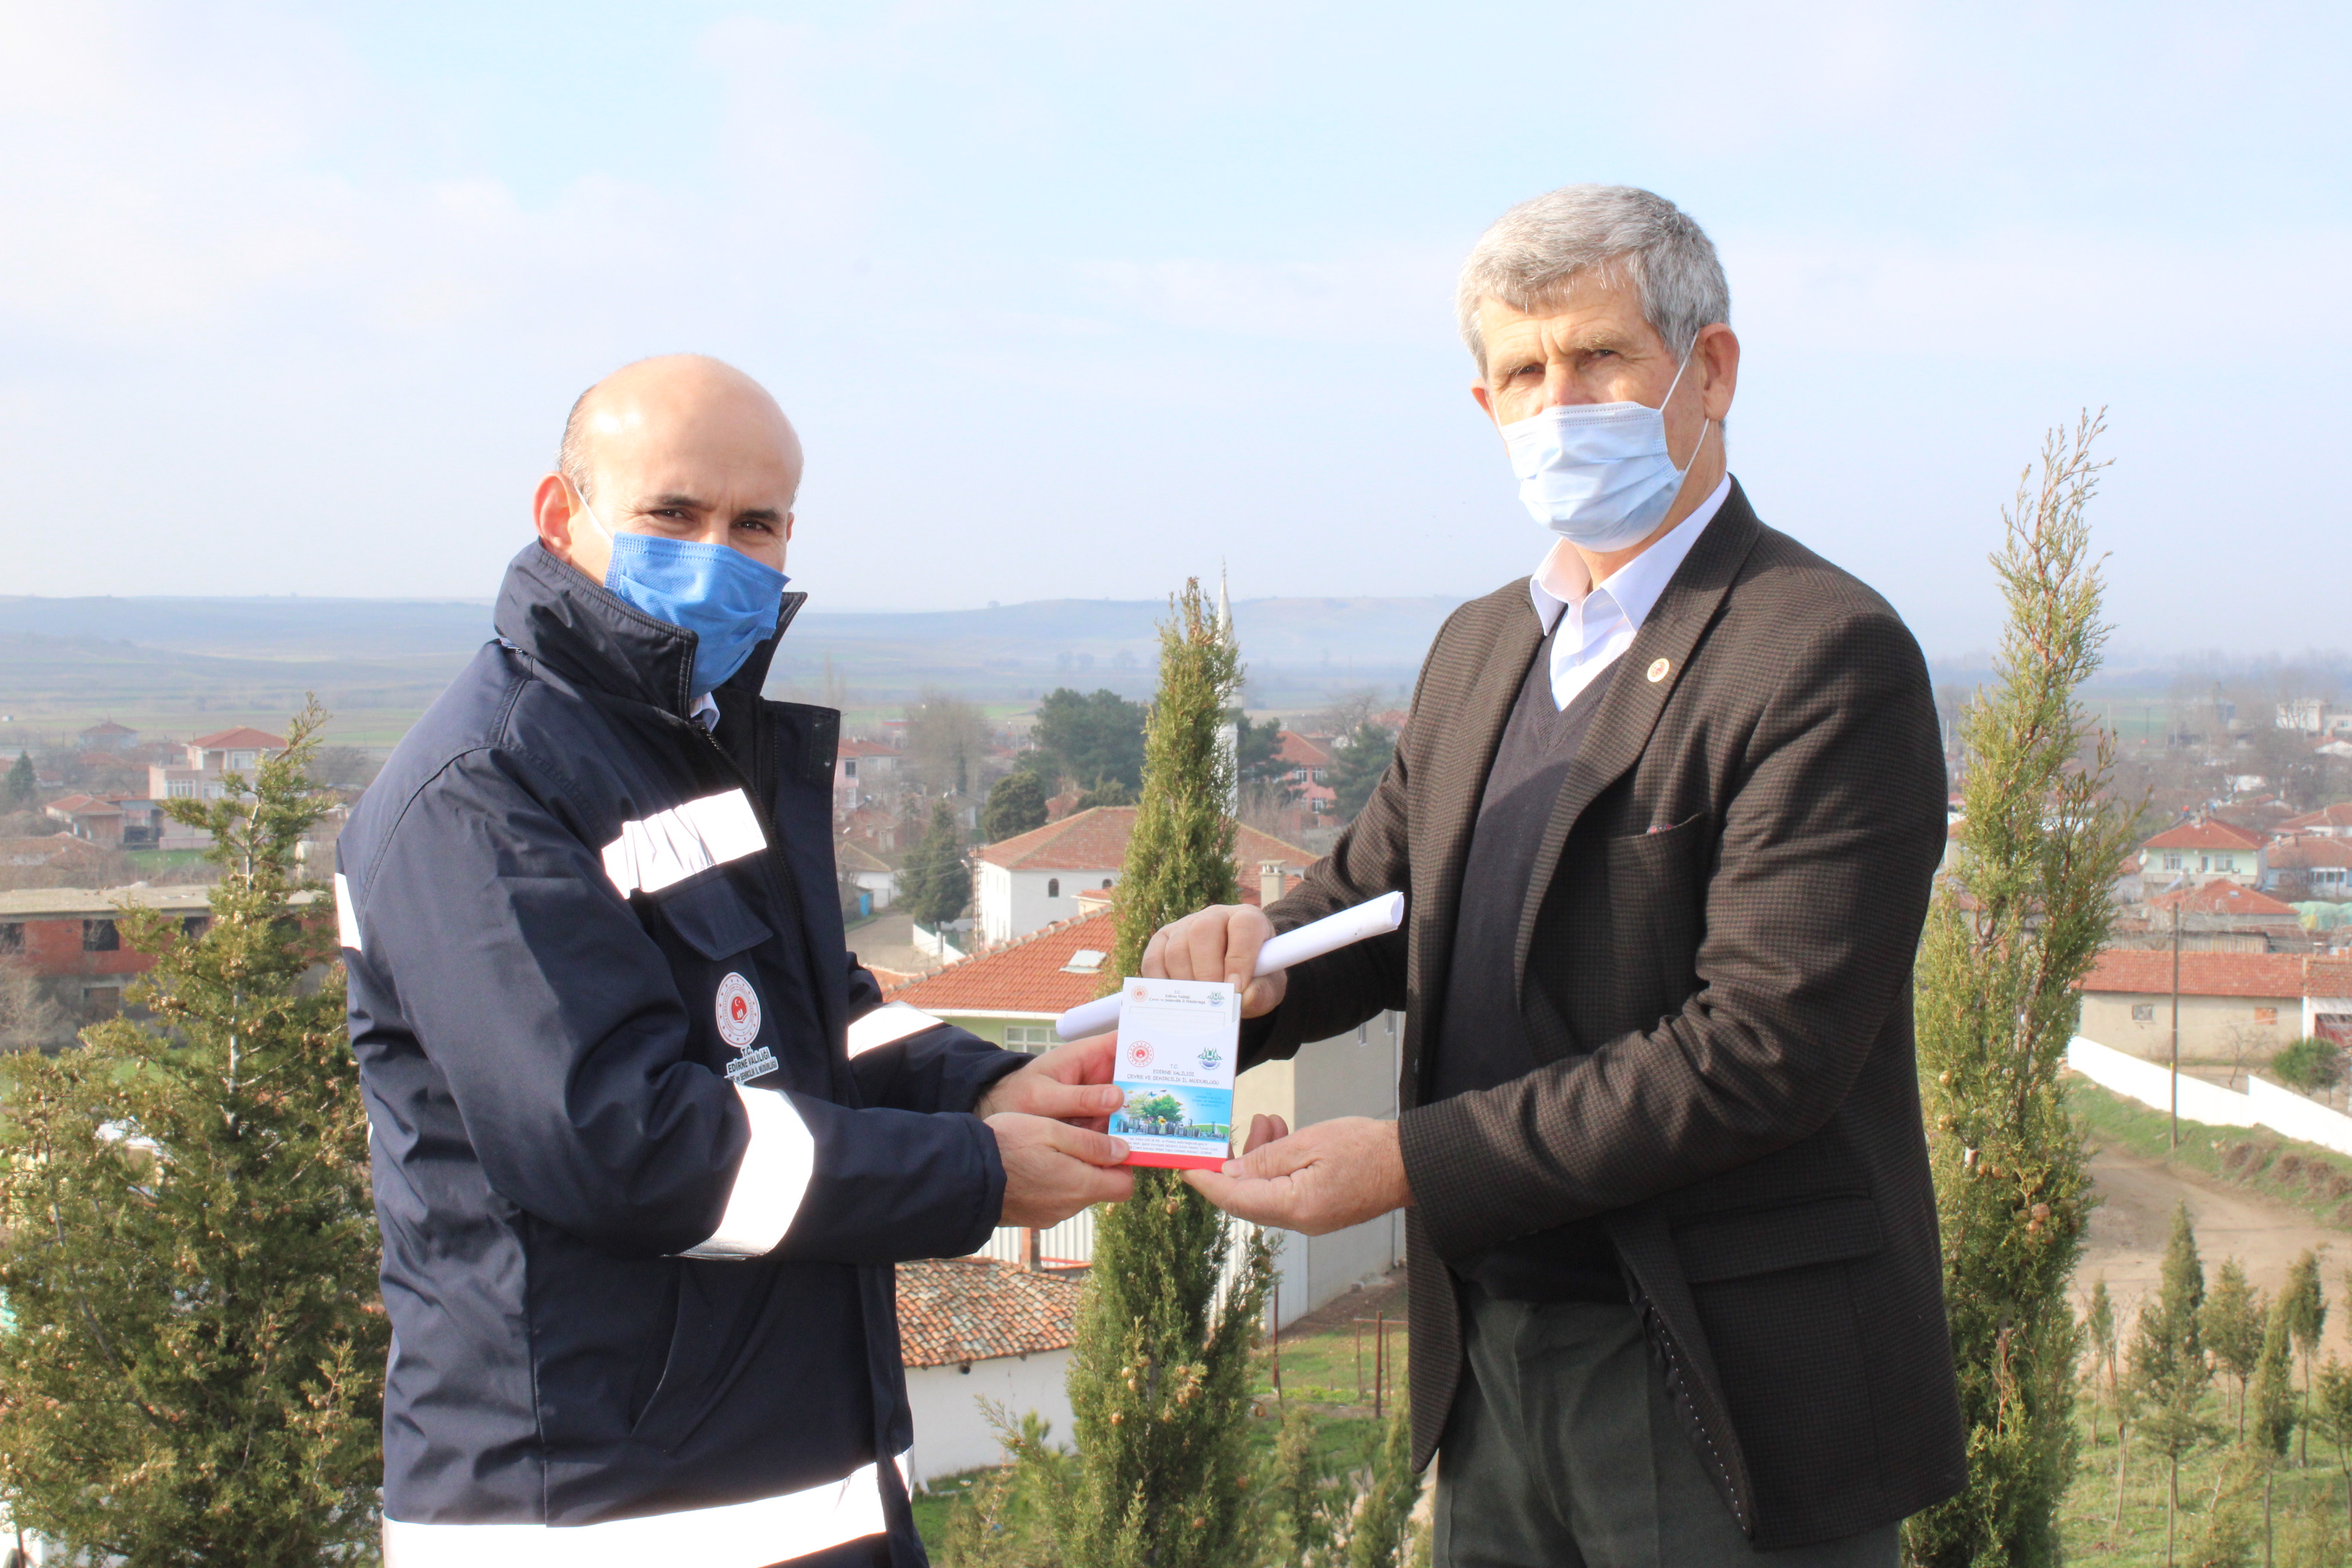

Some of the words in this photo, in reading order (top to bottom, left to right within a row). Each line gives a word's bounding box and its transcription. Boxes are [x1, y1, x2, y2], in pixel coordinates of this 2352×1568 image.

[728, 1059, 748, 1073] EDİRNE
[748, 1048, 770, 1066] VALİLİĞİ
[742, 1046, 753, 1057] T.C.
